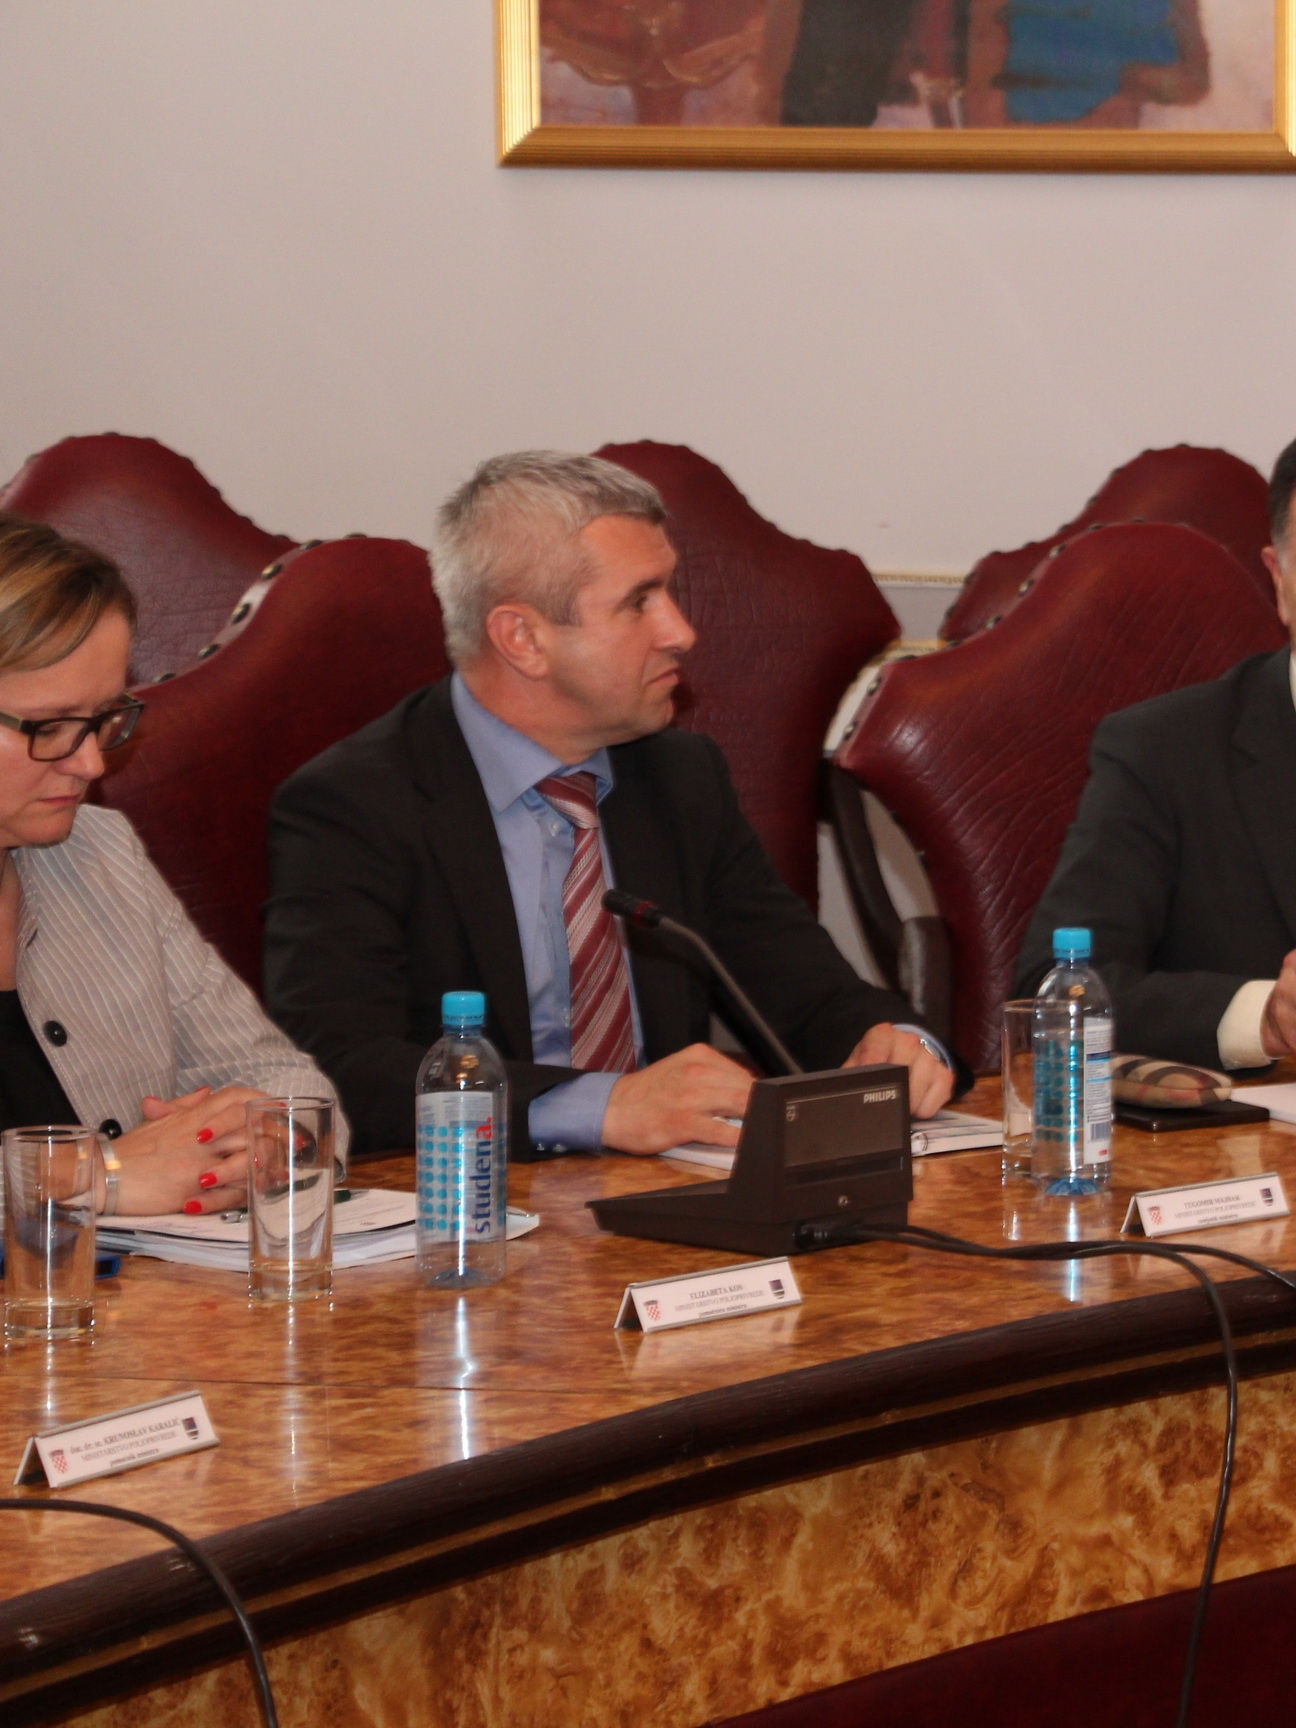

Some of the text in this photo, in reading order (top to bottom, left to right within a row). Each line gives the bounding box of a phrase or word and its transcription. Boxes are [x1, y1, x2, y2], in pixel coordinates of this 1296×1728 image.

[863, 1089, 897, 1104] PHILIPS
[469, 1116, 495, 1234] studena.
[689, 1284, 743, 1300] ELIZABETA KOS
[103, 1427, 147, 1447] KRUNOSLAV
